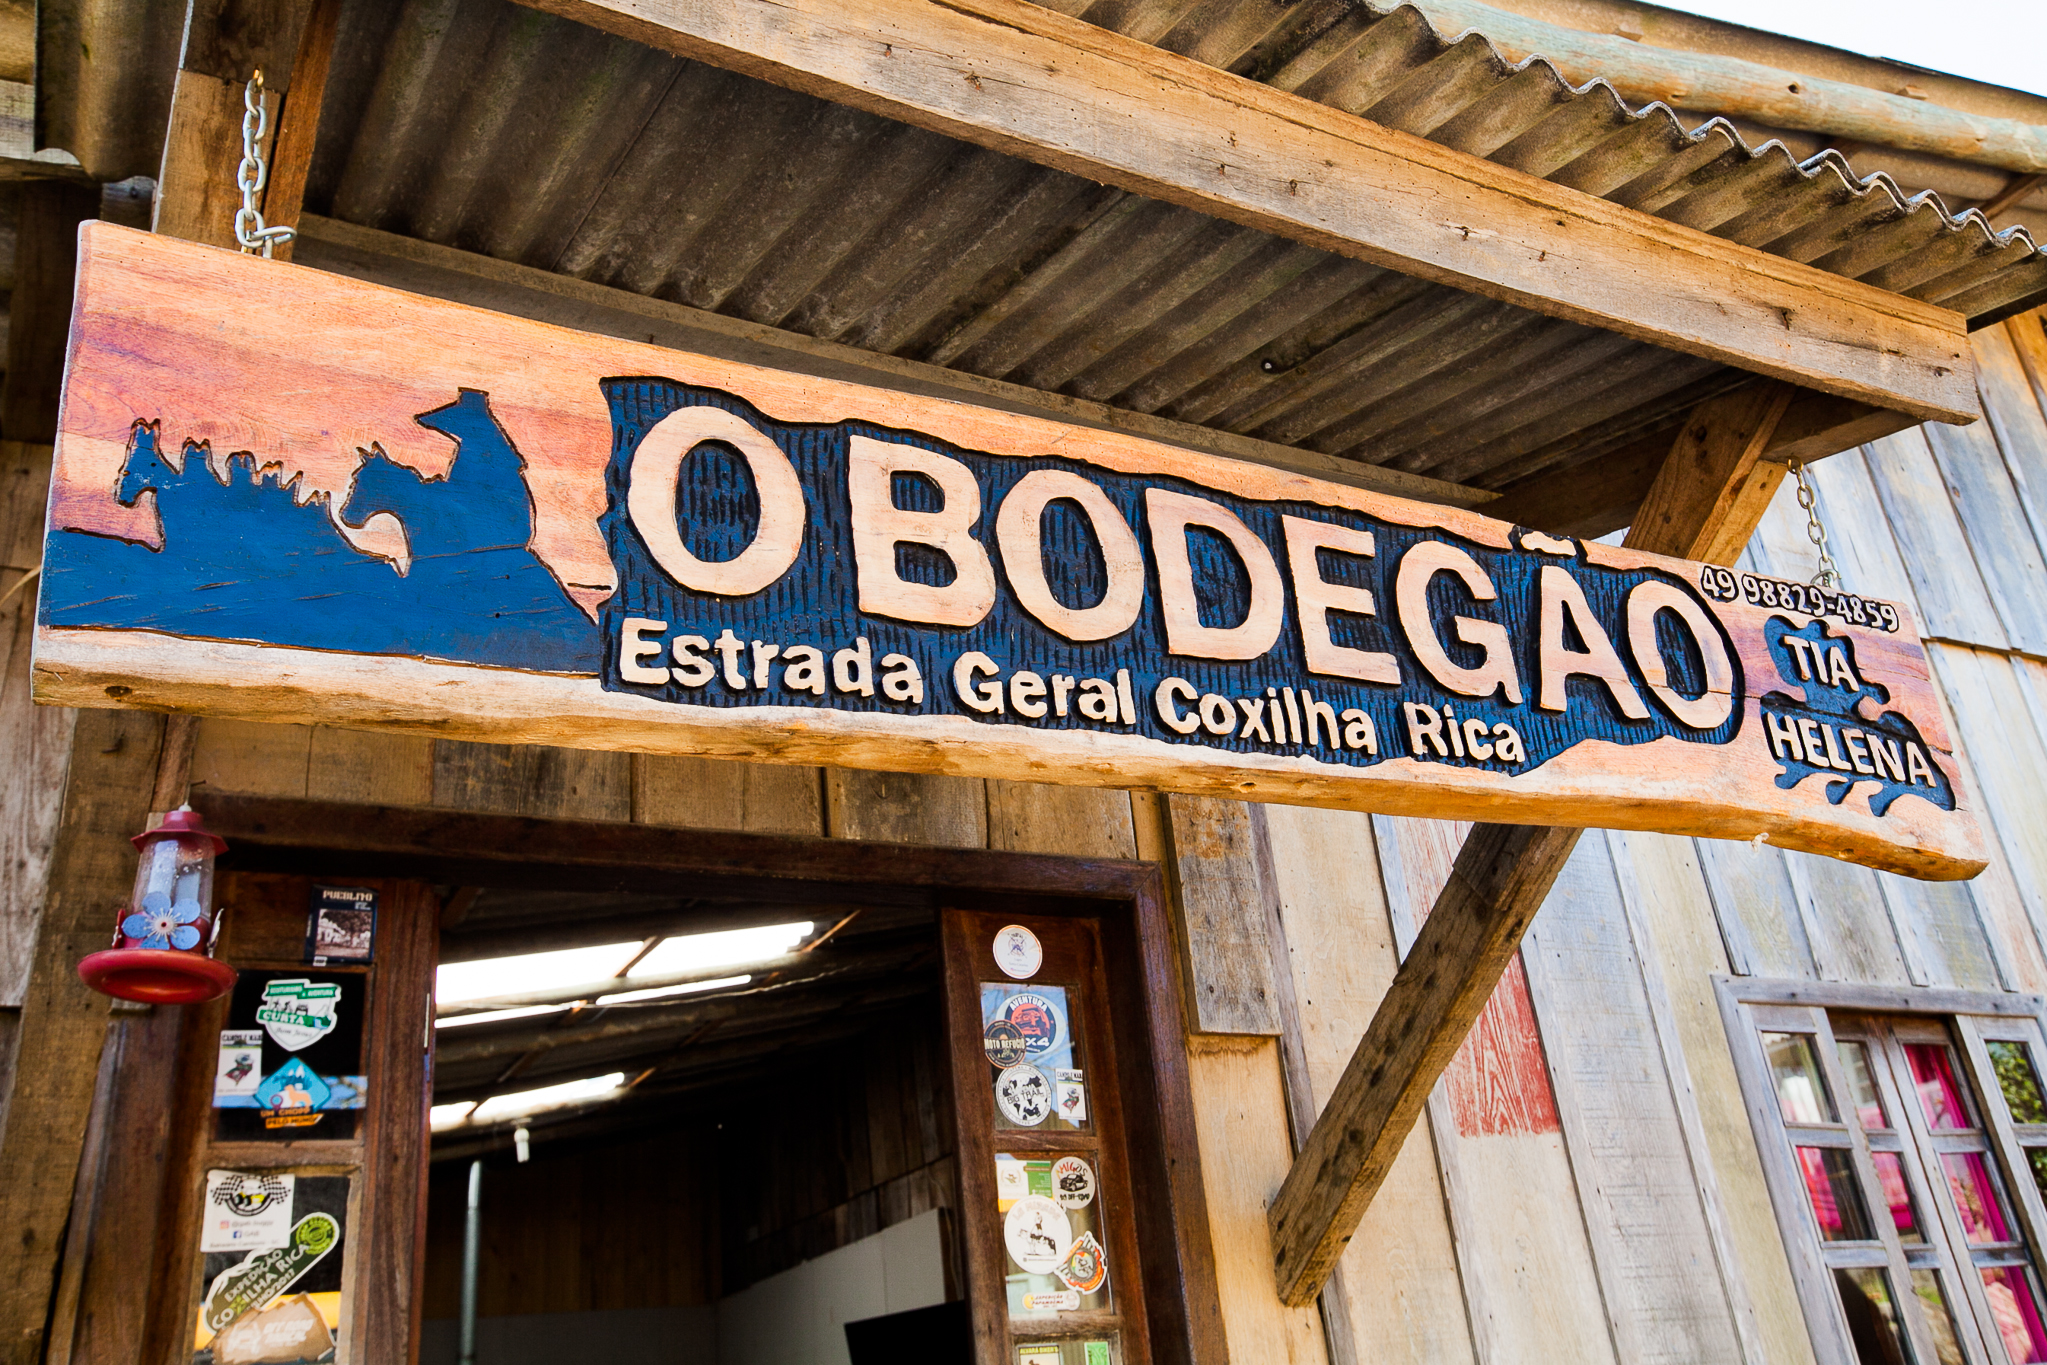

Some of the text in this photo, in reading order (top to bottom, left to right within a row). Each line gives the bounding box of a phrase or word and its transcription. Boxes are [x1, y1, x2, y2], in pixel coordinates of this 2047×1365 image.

[628, 405, 1734, 730] O BODEGÃO
[1702, 567, 1898, 631] 49 98829-4859
[619, 616, 1526, 763] Estrada Geral Coxilha Rica
[1784, 634, 1861, 692] TIA
[1766, 711, 1937, 788] HELENA
[262, 1011, 304, 1026] CURTA
[1009, 995, 1048, 1012] AVENTURA
[984, 1038, 1000, 1050] MOTO
[1006, 1094, 1020, 1104] BIG
[223, 1249, 284, 1303] EXPEDIÇÃO
[275, 1243, 309, 1273] RICA
